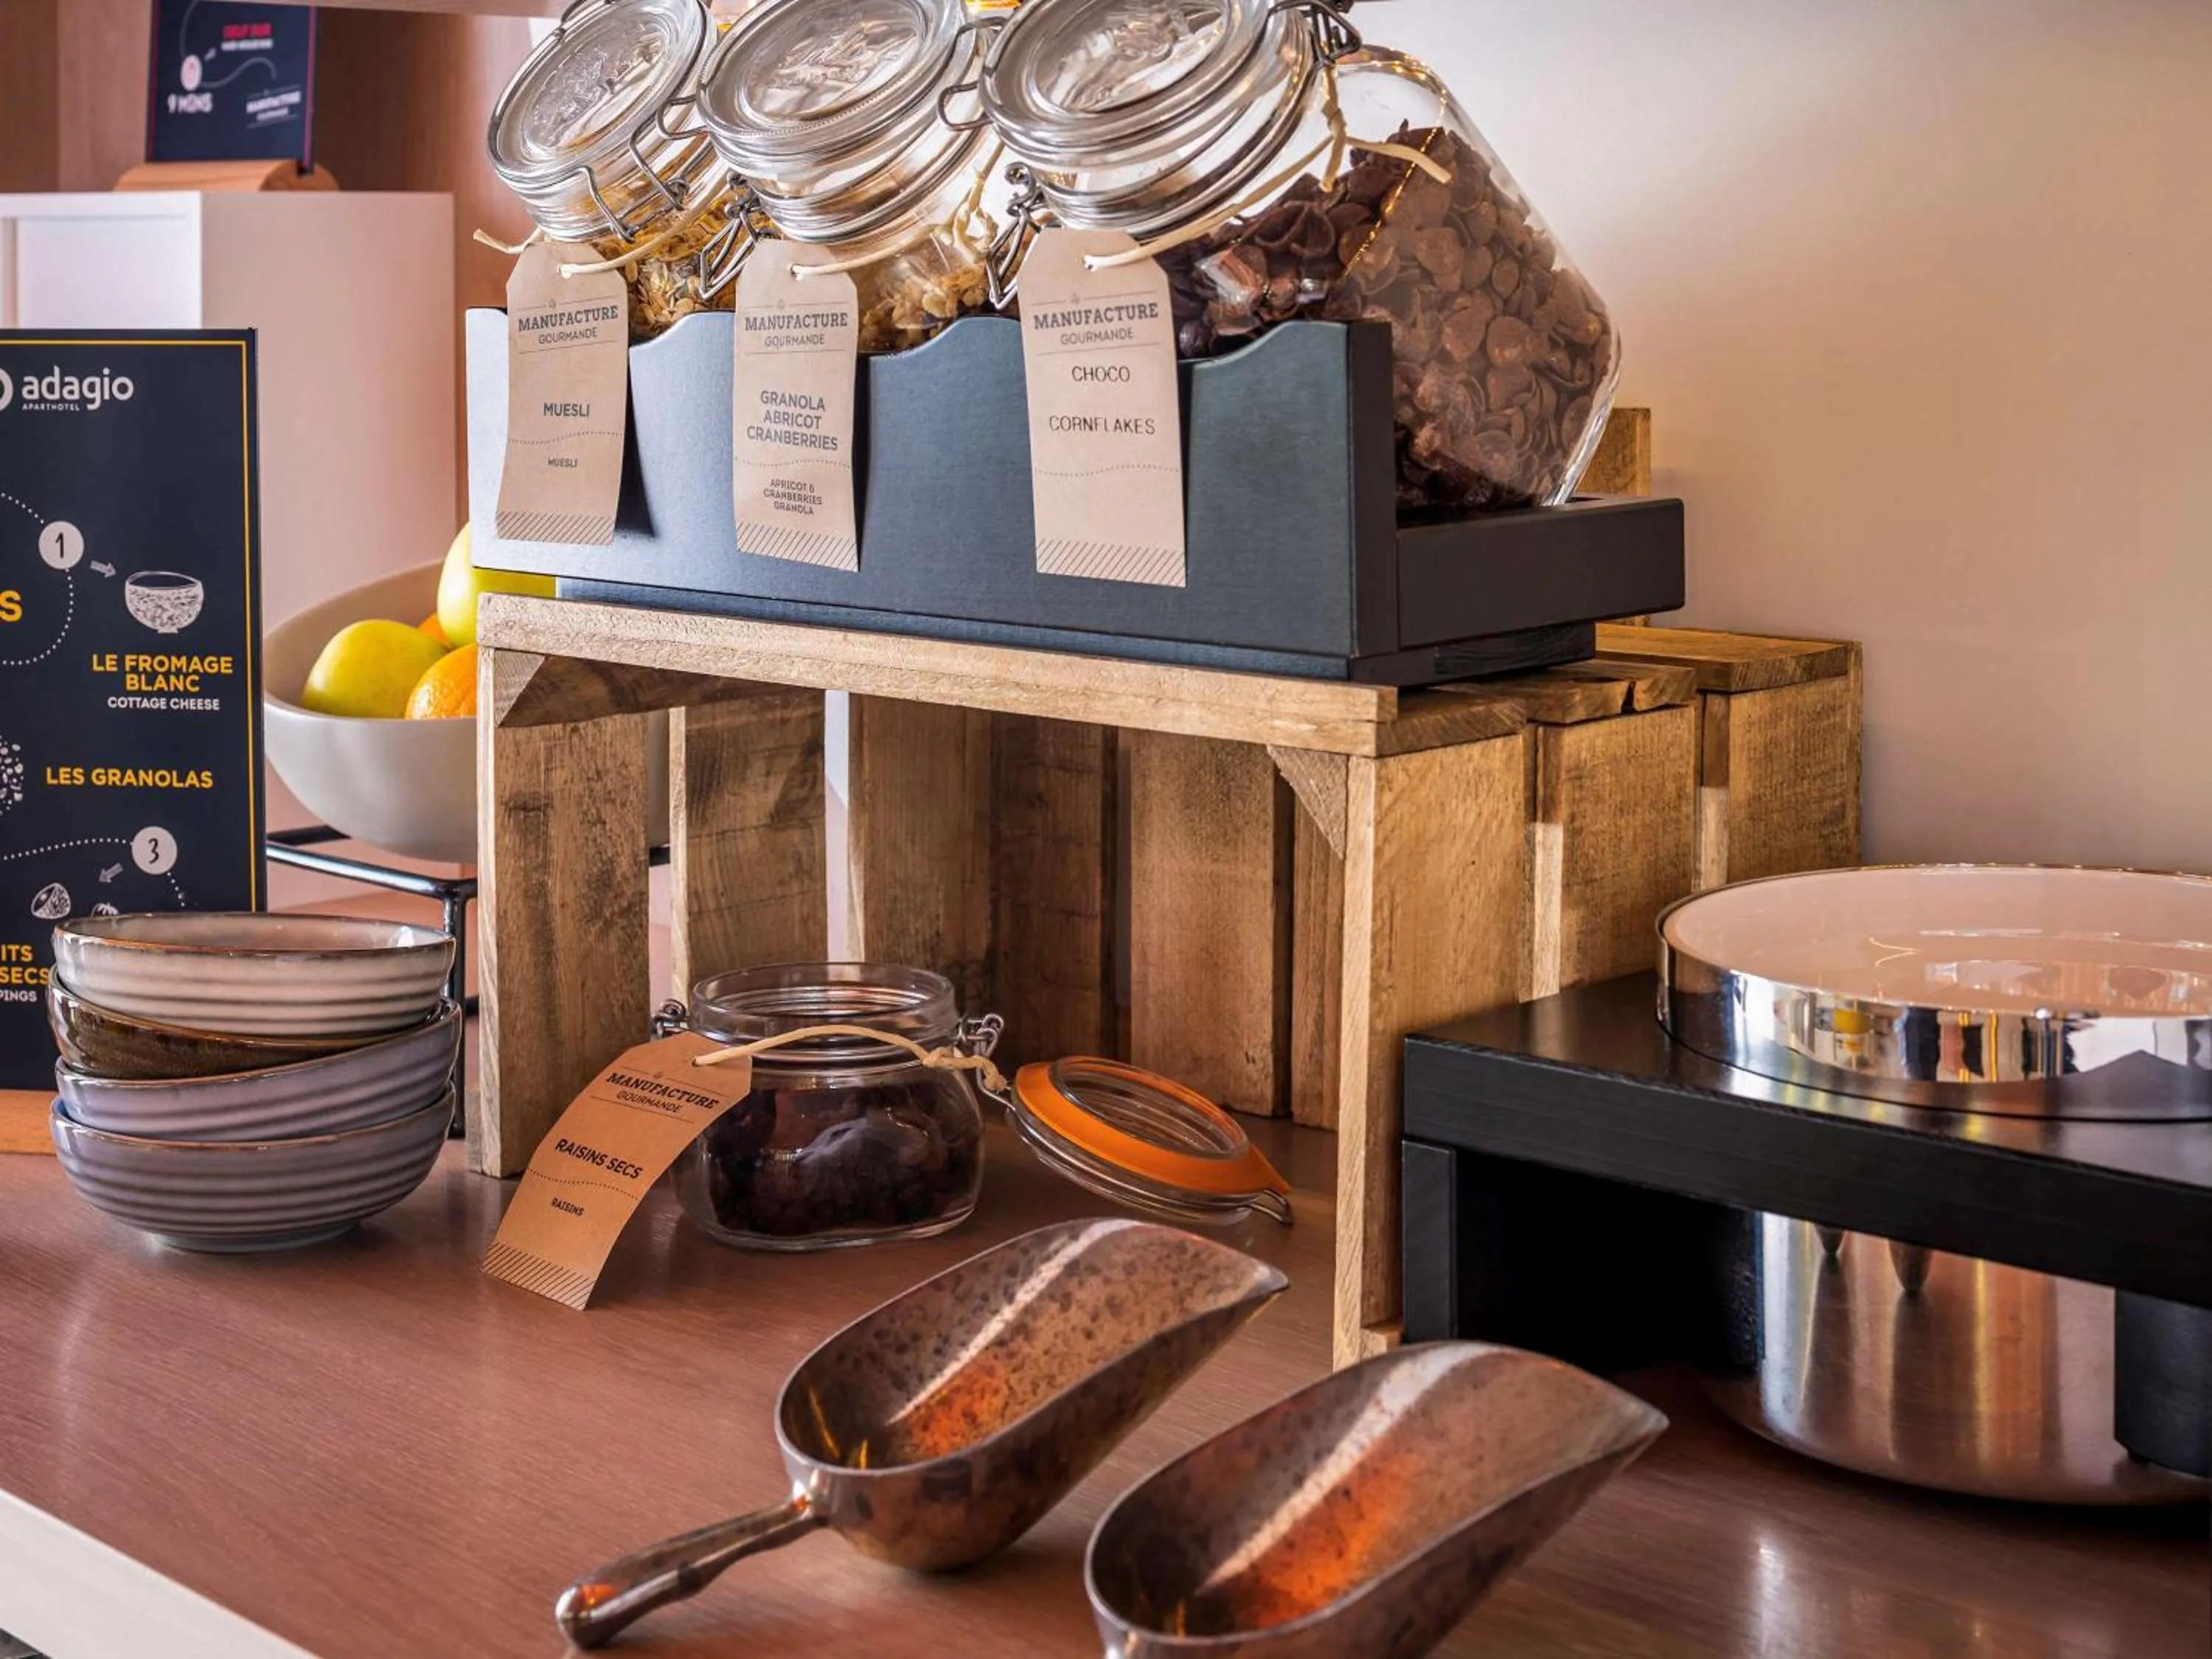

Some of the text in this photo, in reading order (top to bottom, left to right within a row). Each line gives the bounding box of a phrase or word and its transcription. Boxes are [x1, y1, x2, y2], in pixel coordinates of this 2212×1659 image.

[518, 305, 619, 332] MANUFACTURE
[745, 313, 848, 331] MANUFACTURE
[1034, 302, 1158, 330] MANUFACTURE
[538, 327, 598, 344] GOURMANDE
[765, 334, 825, 347] GOURMANDE
[1060, 327, 1134, 346] GOURMANDE
[1071, 365, 1130, 382] CHOCO
[21, 365, 134, 410] adagio
[543, 403, 590, 417] MUESLI
[760, 390, 826, 411] GRANOLA
[763, 410, 821, 429] ABRICOT
[1049, 415, 1155, 435] CORNFLAKES
[747, 425, 838, 451] CRANBERRIES
[548, 458, 578, 468] MUESLI
[770, 479, 807, 491] APRICOT
[763, 487, 822, 505] CRANBERRIES
[773, 501, 815, 515] GRANOLA
[55, 532, 64, 558] 1
[92, 654, 233, 673] LE FROMAGE
[125, 674, 200, 692] BLANC
[108, 697, 220, 711] COTTAGE CHEESE
[46, 767, 213, 789] LES GRANOLAS
[147, 838, 160, 864] 3
[0, 967, 49, 985] SECS
[605, 1072, 720, 1110] MANUFACTURE
[616, 1091, 683, 1113] GOURMANDE
[554, 1138, 644, 1180] RAISINS SECS
[551, 1197, 585, 1217] RAISINS
